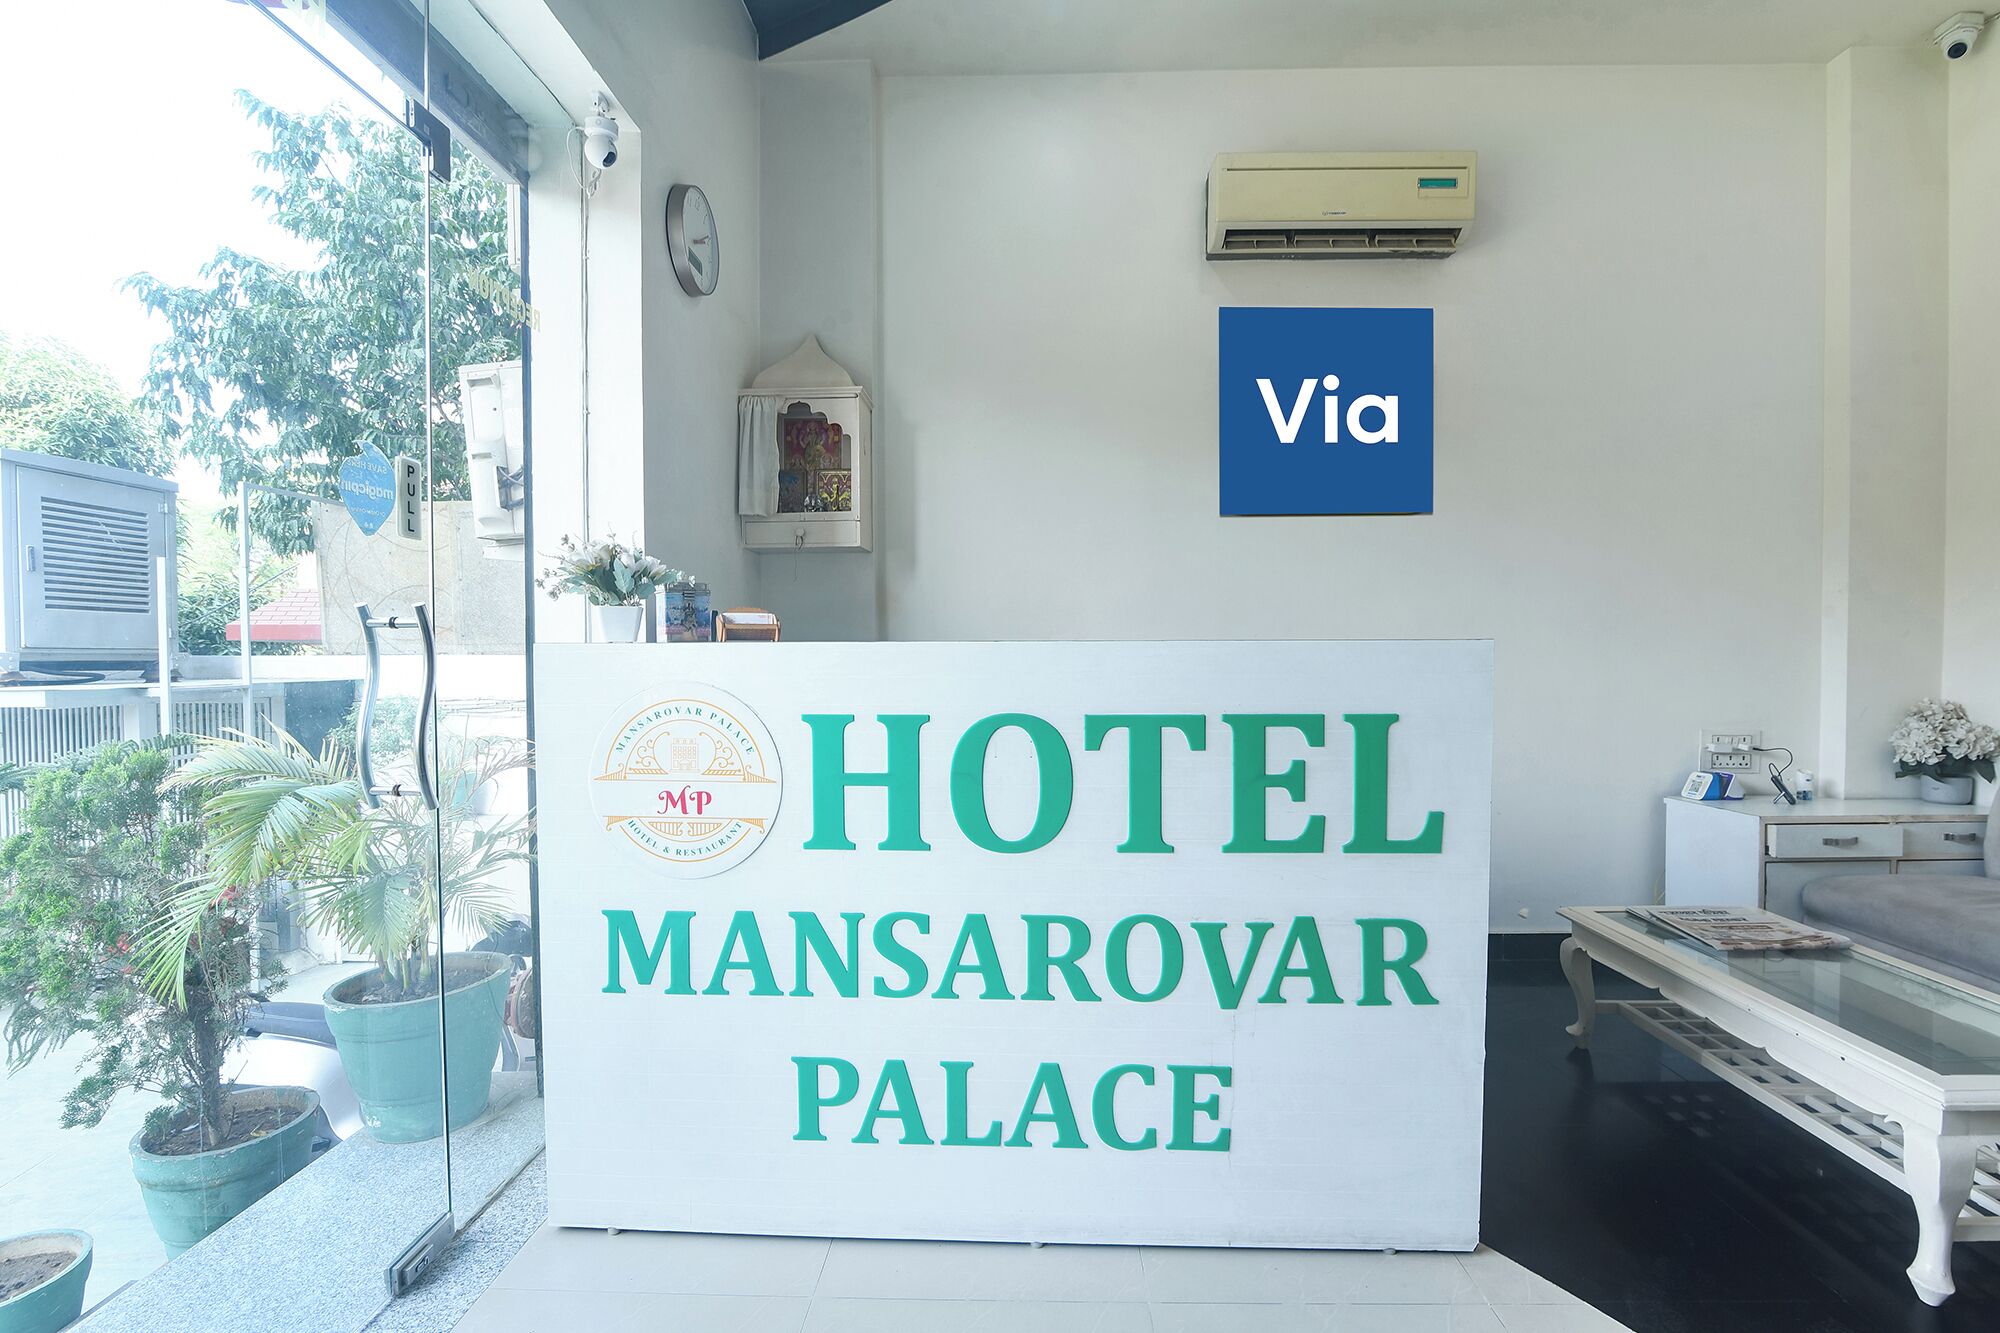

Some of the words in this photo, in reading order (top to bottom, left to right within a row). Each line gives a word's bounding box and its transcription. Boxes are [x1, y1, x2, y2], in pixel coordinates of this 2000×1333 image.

[1256, 375, 1399, 444] Via
[407, 465, 415, 532] PULL
[616, 706, 703, 753] MANSAROVAR
[709, 712, 755, 755] PALACE
[657, 785, 712, 815] MP
[802, 713, 1444, 854] HOTEL
[627, 819, 658, 849] HOTEL
[663, 845, 670, 853] &
[675, 822, 742, 856] RESTAURANT
[603, 910, 1440, 1010] MANSAROVAR
[792, 1057, 1233, 1152] PALACE
